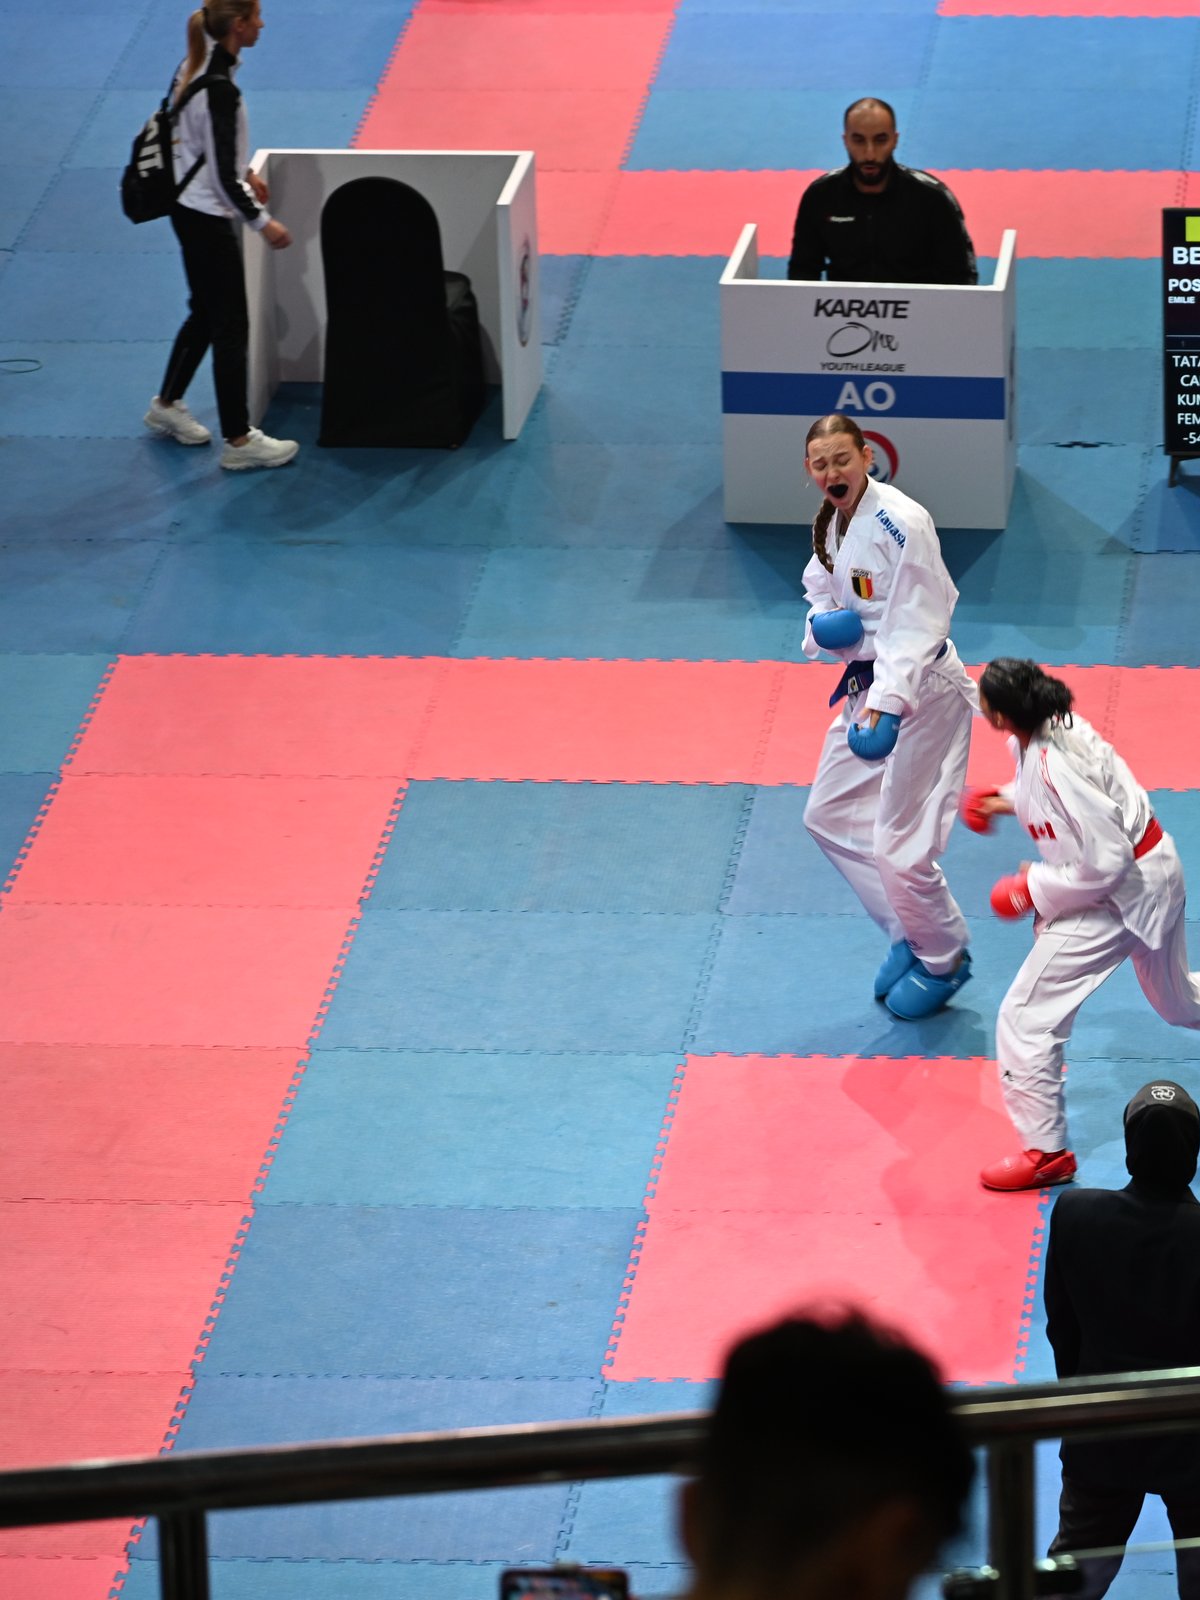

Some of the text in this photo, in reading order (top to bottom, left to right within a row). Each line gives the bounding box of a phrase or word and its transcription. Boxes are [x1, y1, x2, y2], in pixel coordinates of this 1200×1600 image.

[814, 298, 910, 319] KARATE
[1168, 296, 1196, 304] EMILIE
[826, 322, 898, 358] One
[820, 362, 905, 372] YOUTH LEAGUE
[835, 381, 897, 411] AO
